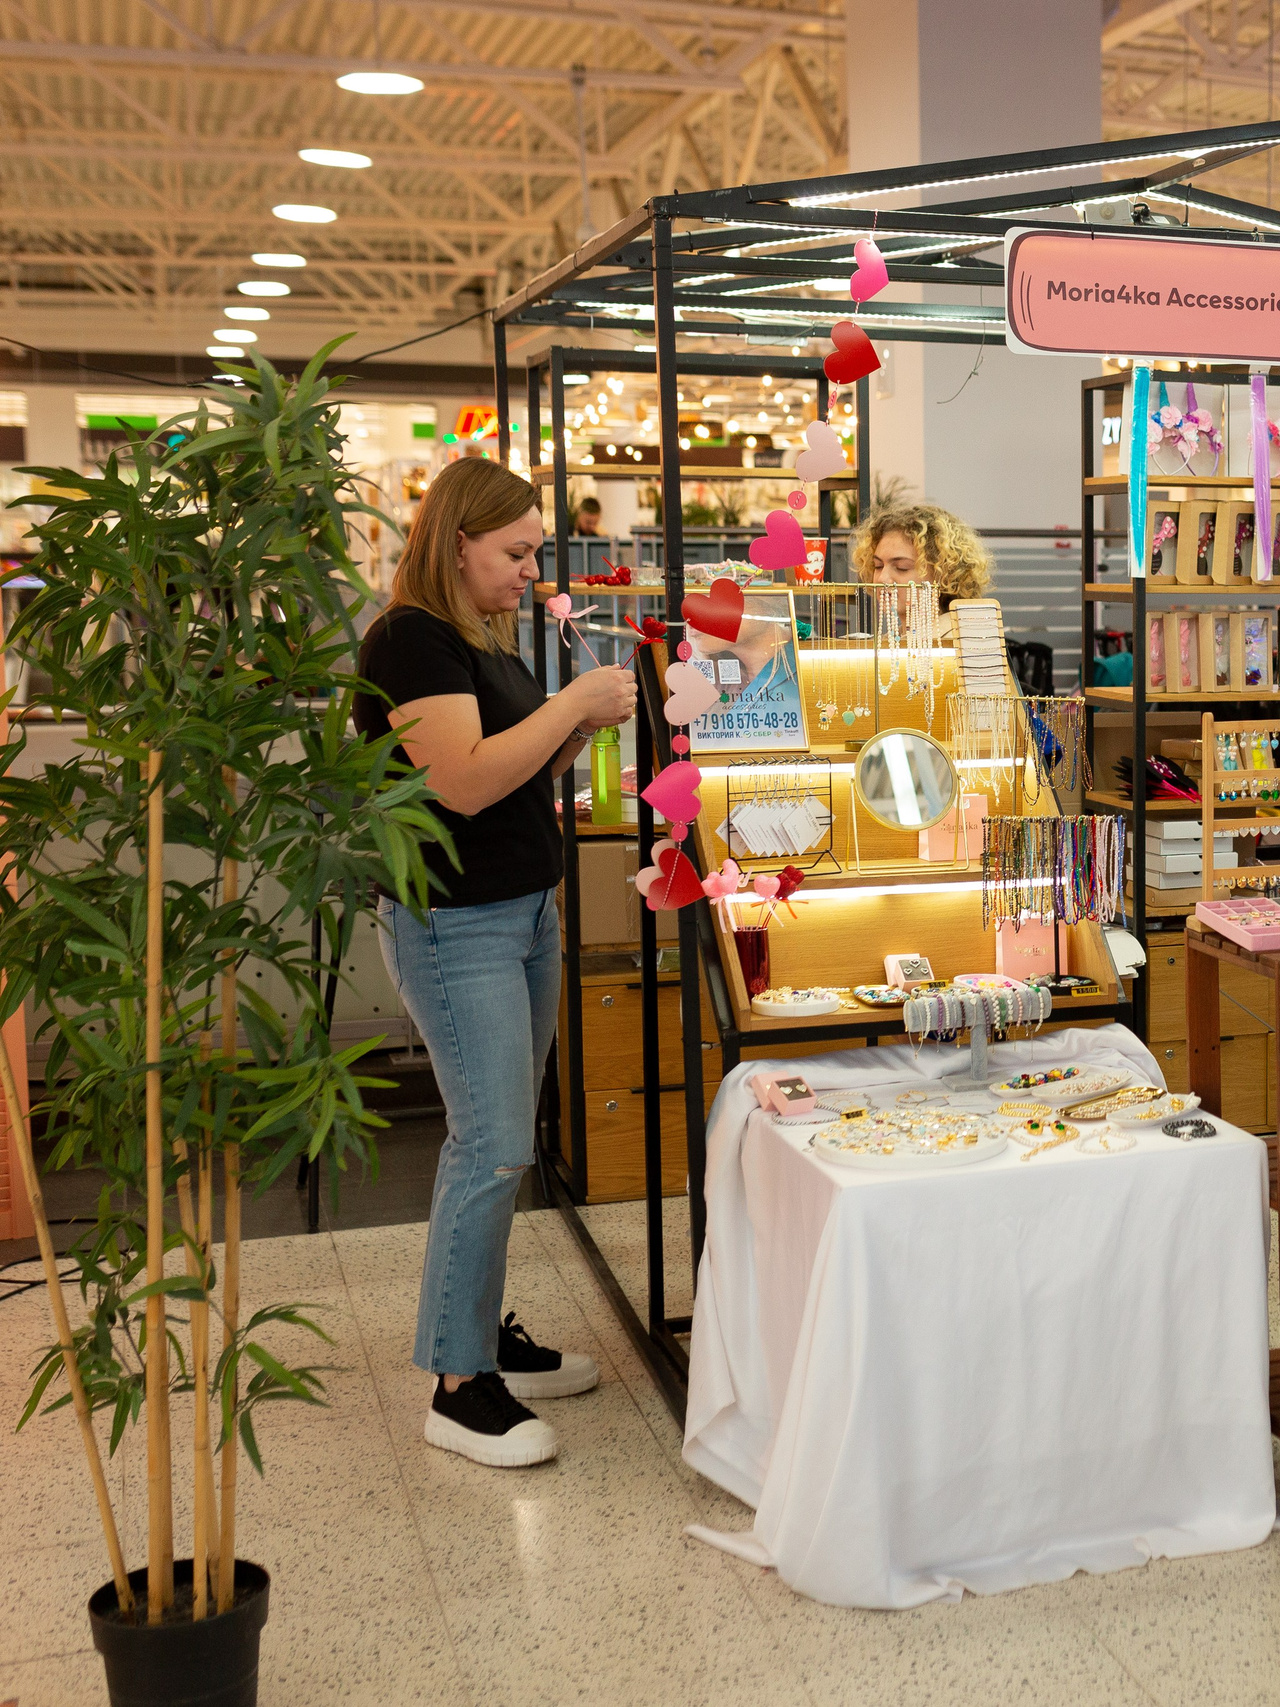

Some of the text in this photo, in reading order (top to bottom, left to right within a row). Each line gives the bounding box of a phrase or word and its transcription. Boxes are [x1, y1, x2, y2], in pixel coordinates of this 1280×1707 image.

[1046, 280, 1161, 306] Moria4ka
[693, 711, 798, 730] +7 918 576-48-28
[697, 731, 734, 739] ВИКТОРИЯ
